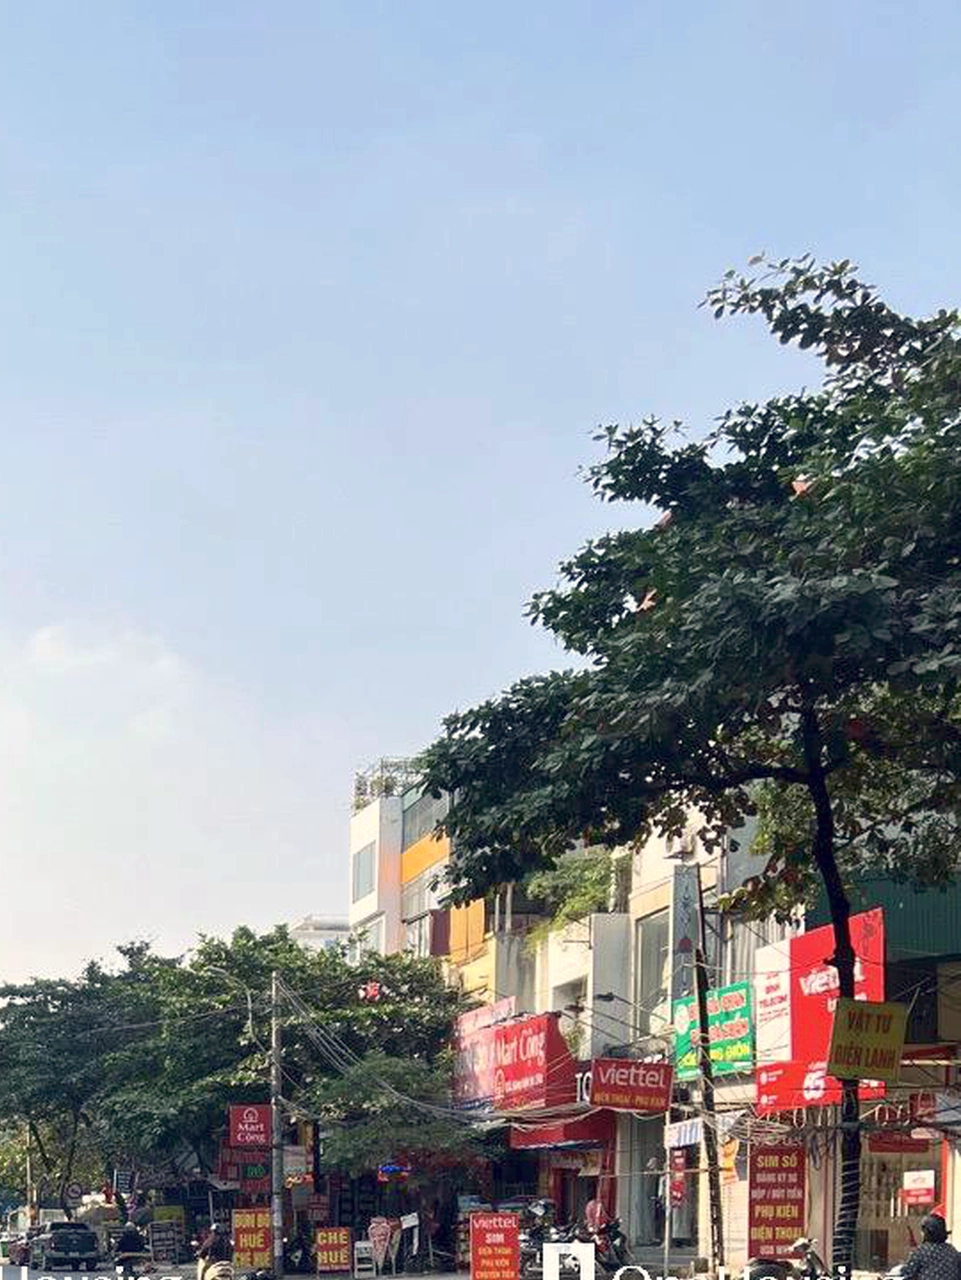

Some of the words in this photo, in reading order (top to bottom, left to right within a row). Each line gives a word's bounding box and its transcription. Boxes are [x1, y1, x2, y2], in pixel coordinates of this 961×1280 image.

[598, 1063, 666, 1088] viettel
[756, 1156, 780, 1168] SIM
[473, 1216, 518, 1229] viettel
